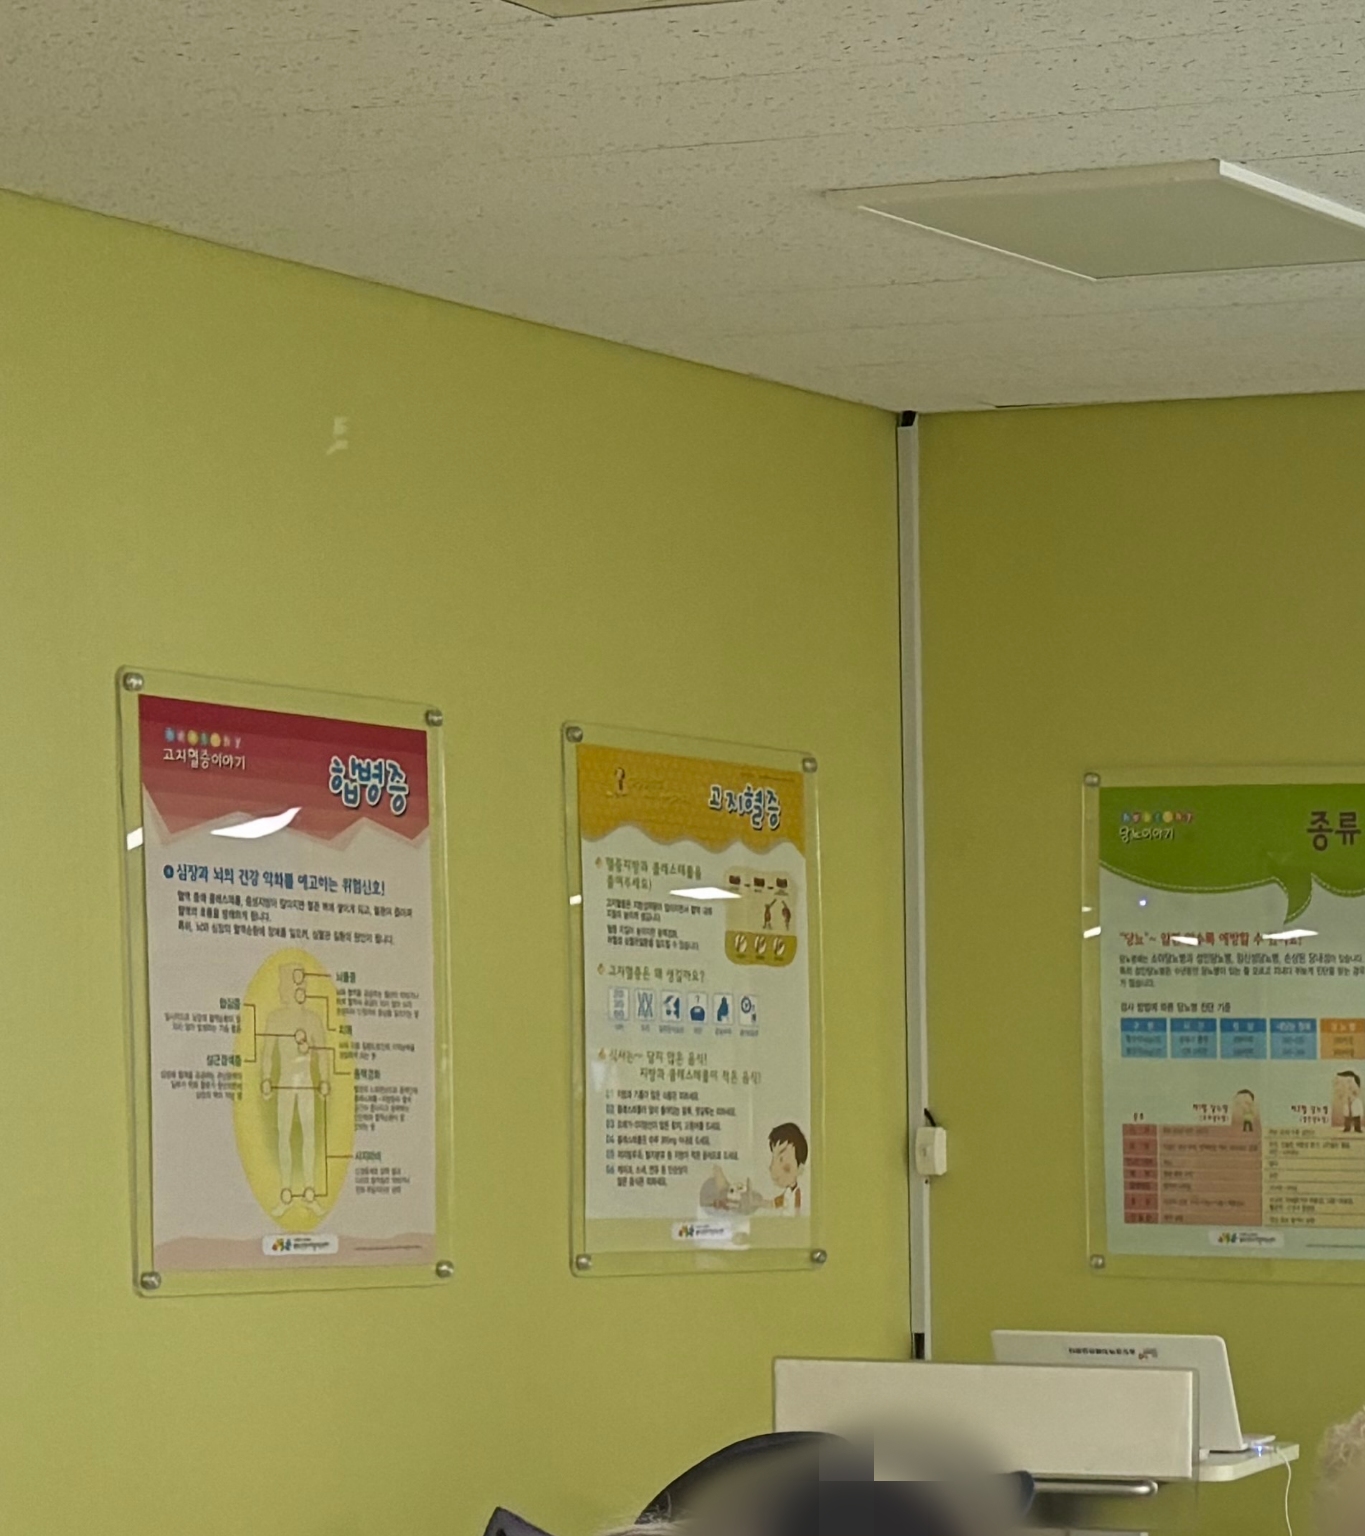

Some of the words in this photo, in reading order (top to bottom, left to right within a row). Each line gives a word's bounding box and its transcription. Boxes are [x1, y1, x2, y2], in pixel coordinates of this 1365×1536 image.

[328, 754, 409, 817] 합병증
[708, 782, 782, 831] 고지혈증
[1306, 810, 1362, 852] 종류
